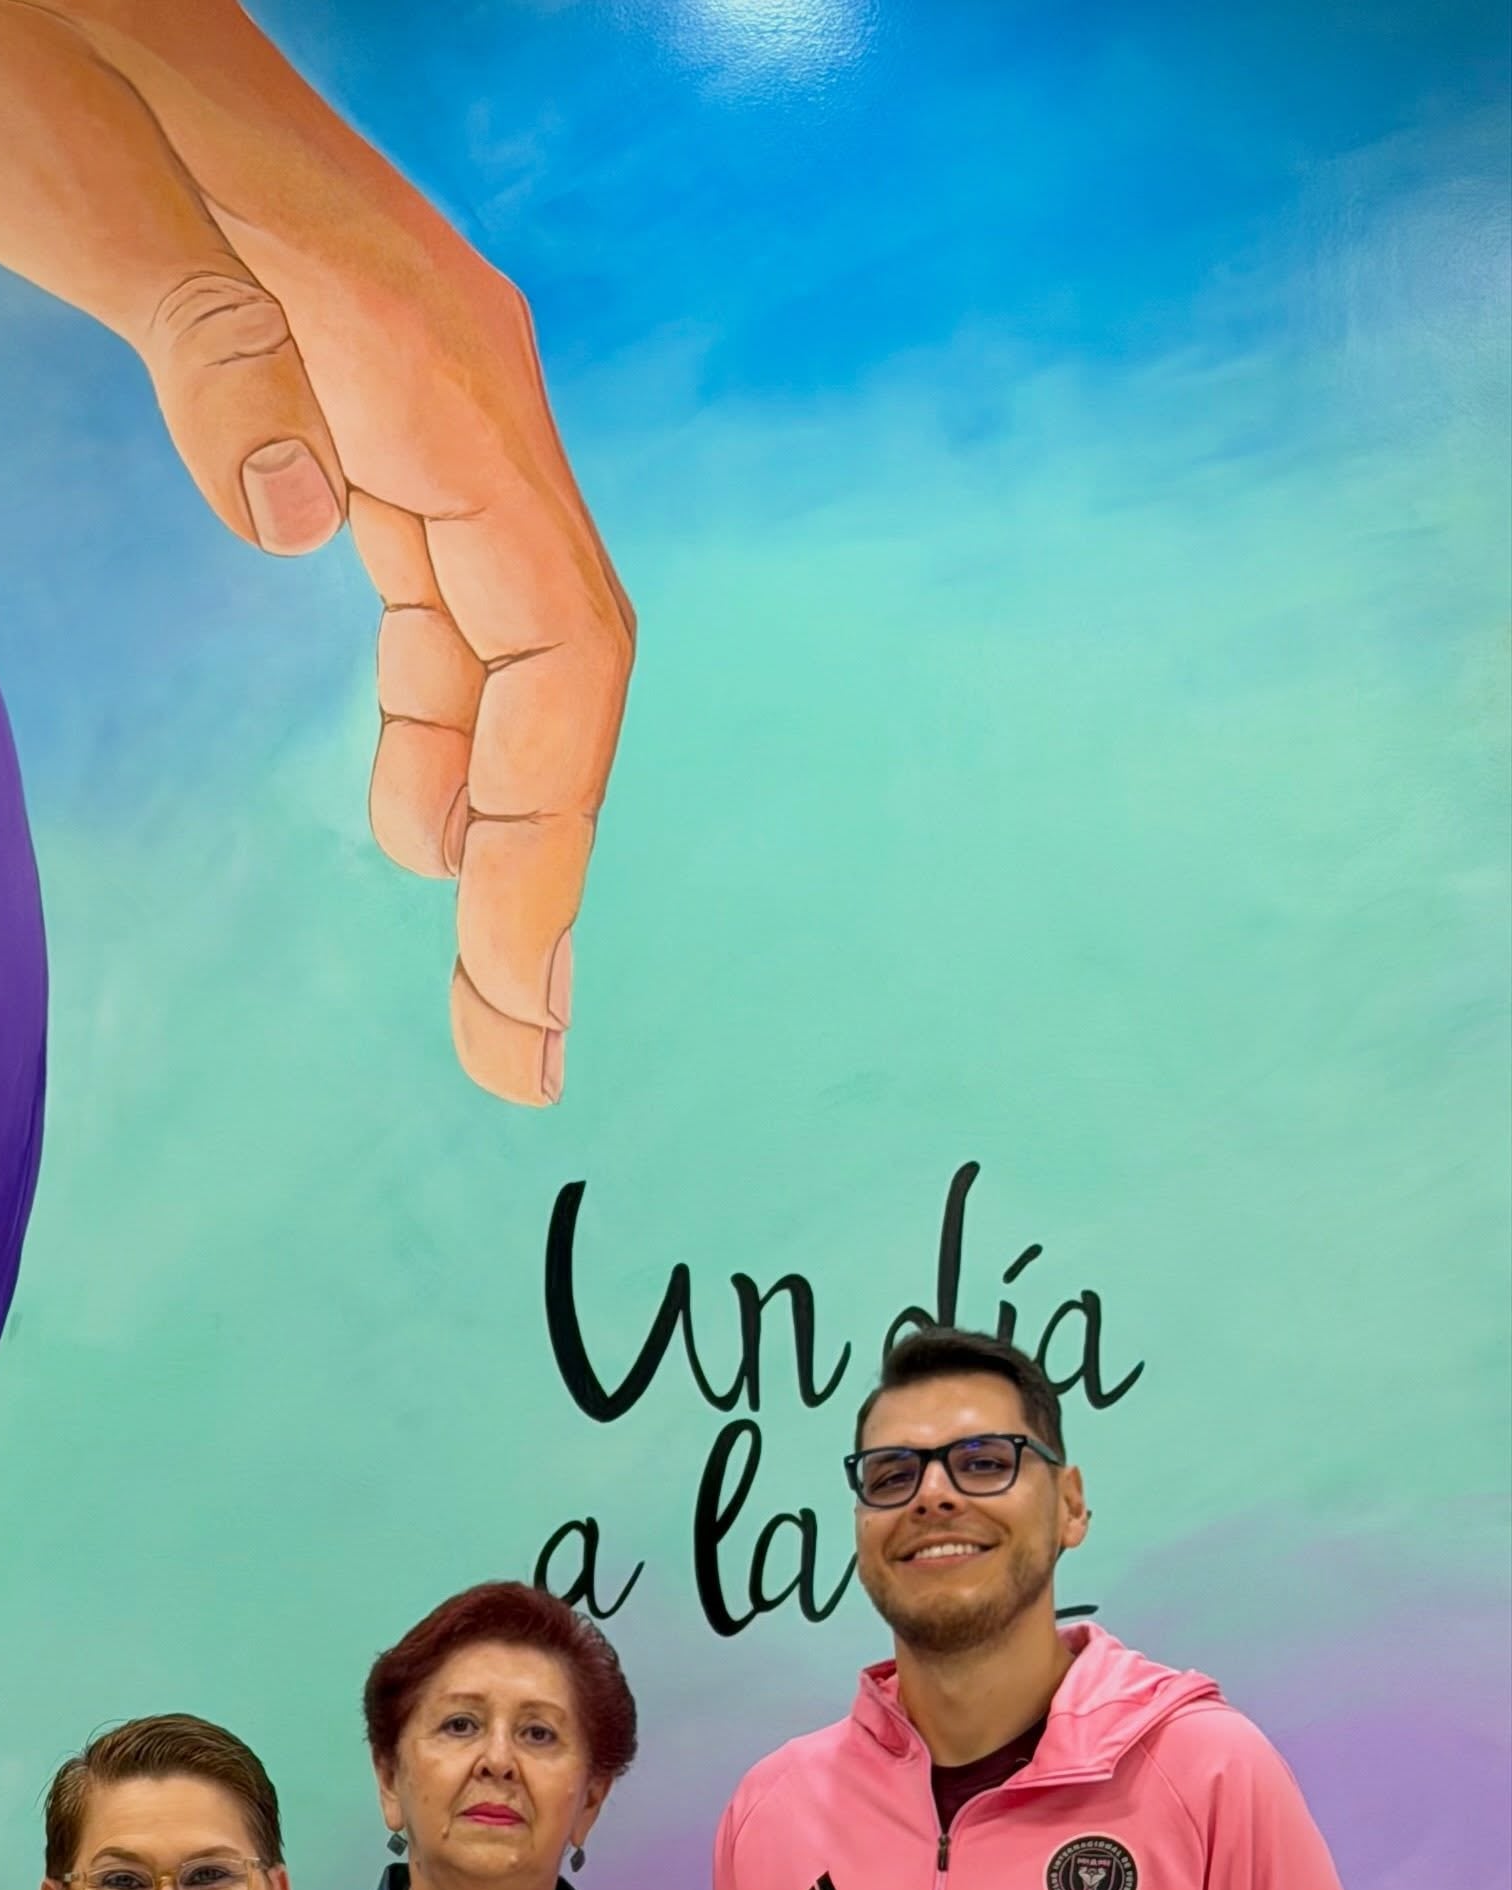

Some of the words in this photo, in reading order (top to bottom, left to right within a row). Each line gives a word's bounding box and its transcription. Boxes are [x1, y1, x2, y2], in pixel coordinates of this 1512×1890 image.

[544, 1180, 852, 1423] Un
[533, 1516, 645, 1620] a
[693, 1418, 857, 1638] la
